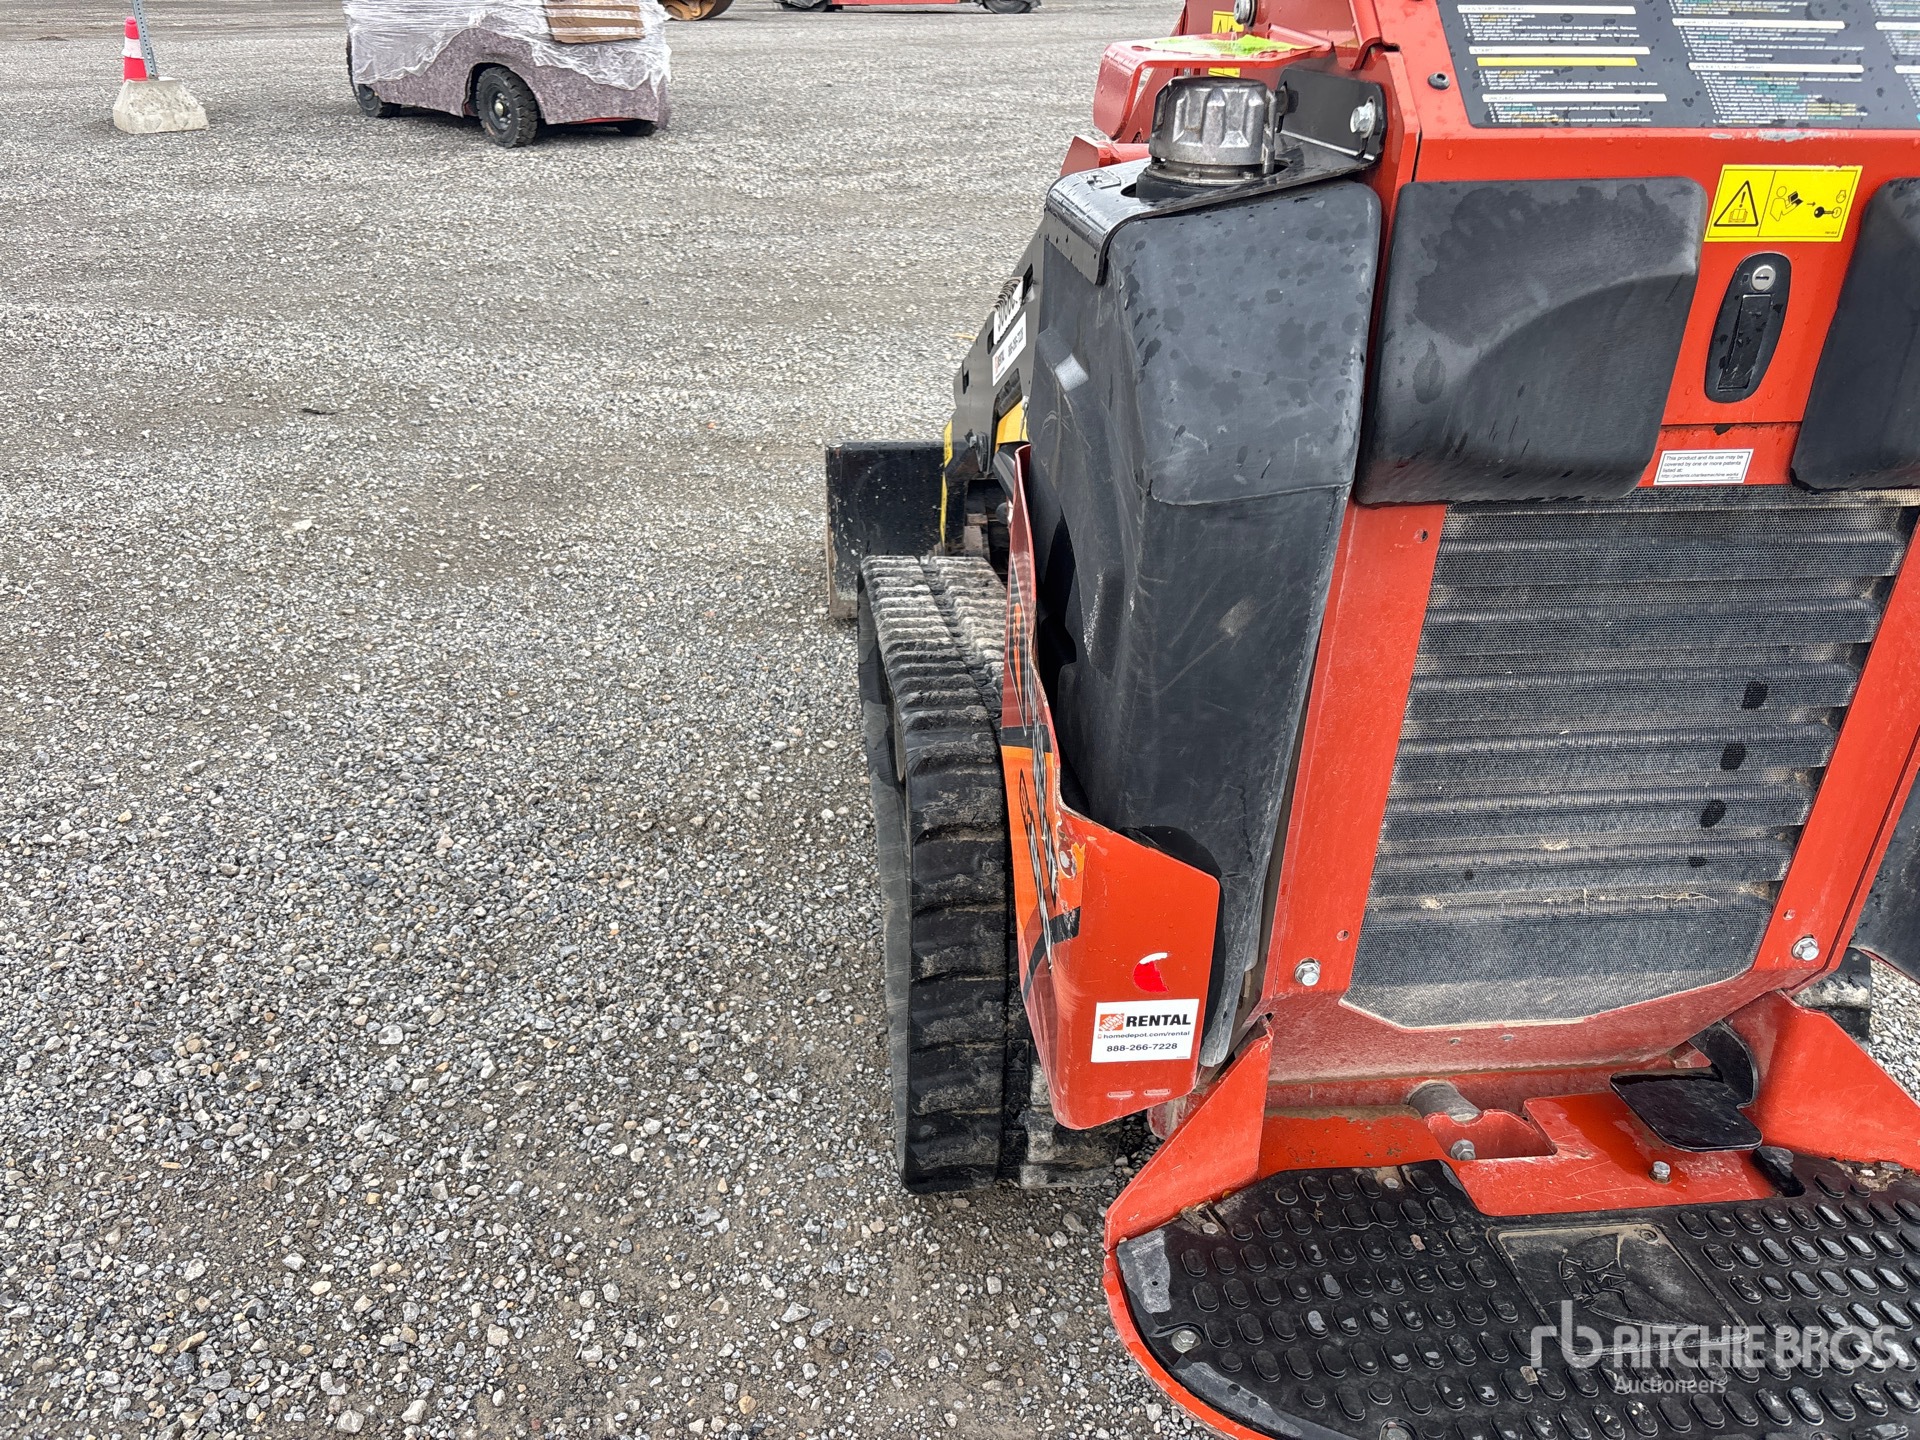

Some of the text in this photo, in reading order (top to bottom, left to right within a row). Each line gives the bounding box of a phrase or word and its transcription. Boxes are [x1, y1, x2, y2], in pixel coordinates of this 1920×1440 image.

[1126, 1014, 1191, 1027] RENTAL
[1103, 1030, 1190, 1039] homedepot.com/rental
[1106, 1043, 1178, 1052] 888-266-7228
